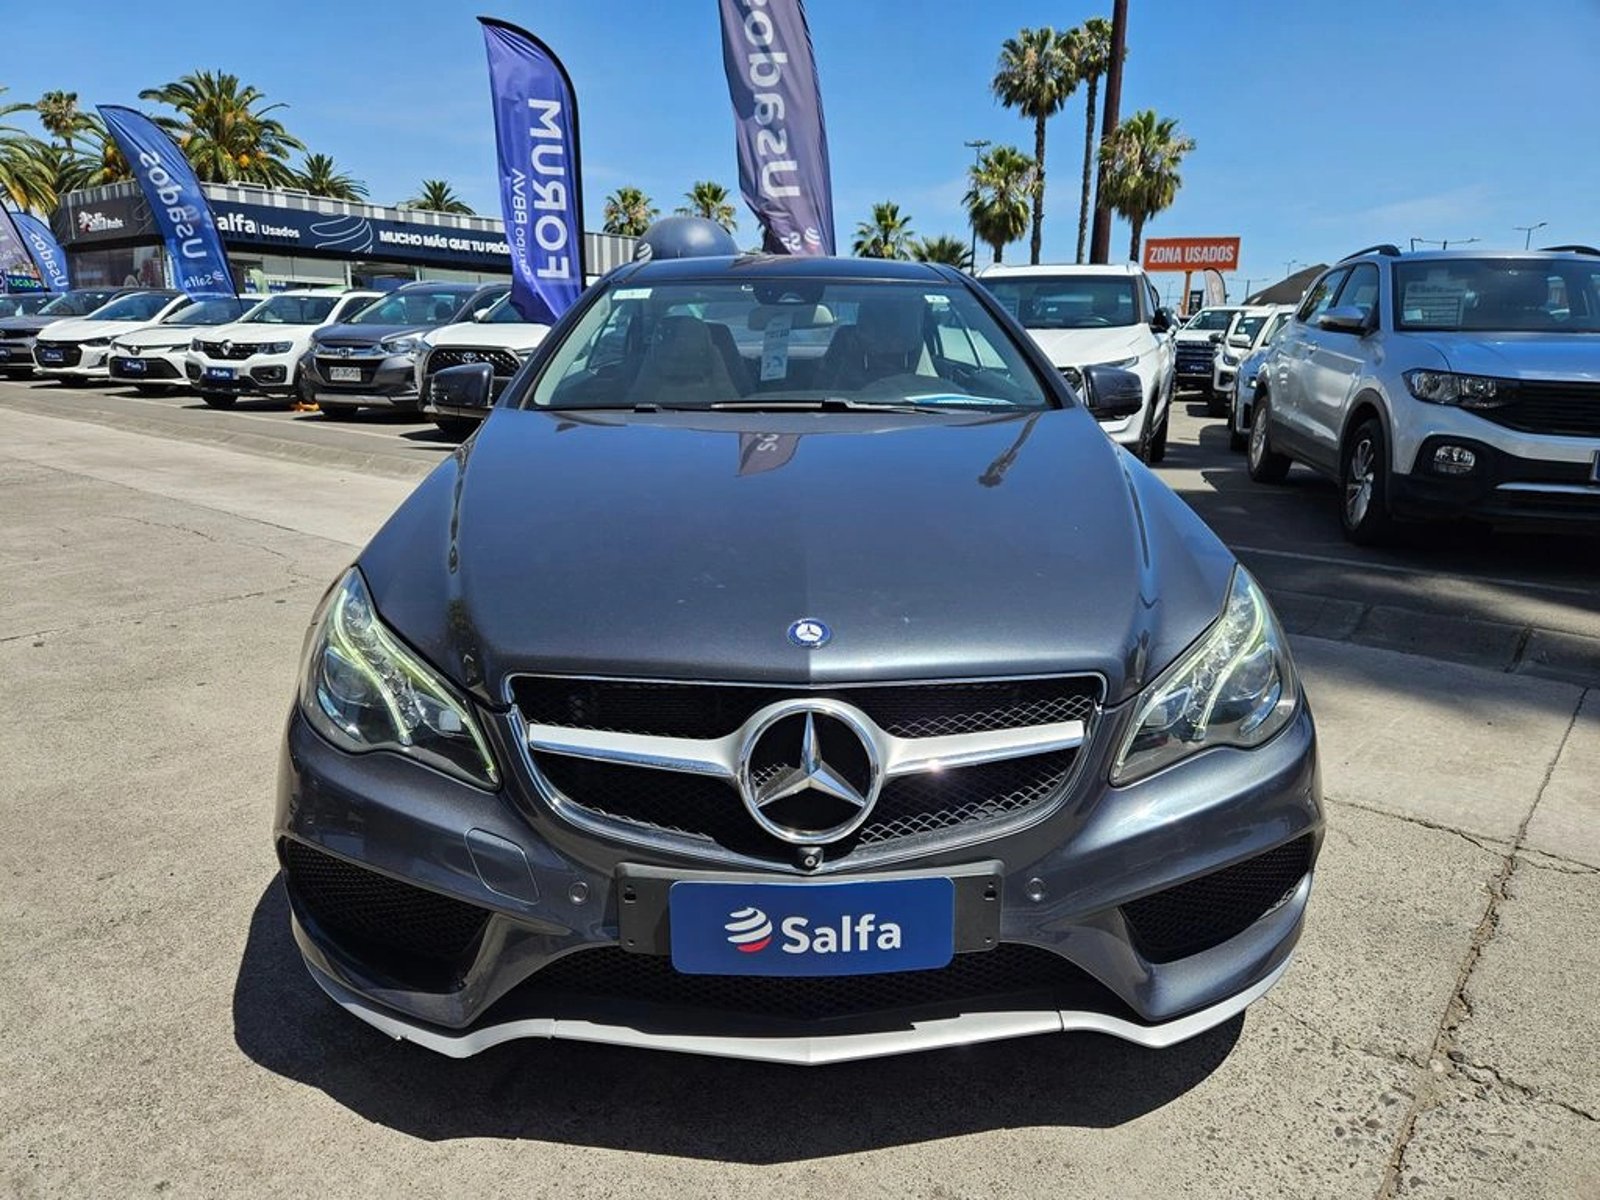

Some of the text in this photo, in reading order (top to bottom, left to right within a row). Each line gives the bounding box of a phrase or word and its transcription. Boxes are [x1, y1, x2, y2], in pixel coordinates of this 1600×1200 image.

[213, 212, 300, 239] alfa Usados
[379, 231, 422, 246] MUCHO
[423, 234, 448, 248] MÁS
[448, 238, 471, 251] QUE
[471, 240, 485, 252] TU
[1149, 245, 1234, 264] ZONA USADOS
[781, 914, 902, 955] Salfa
